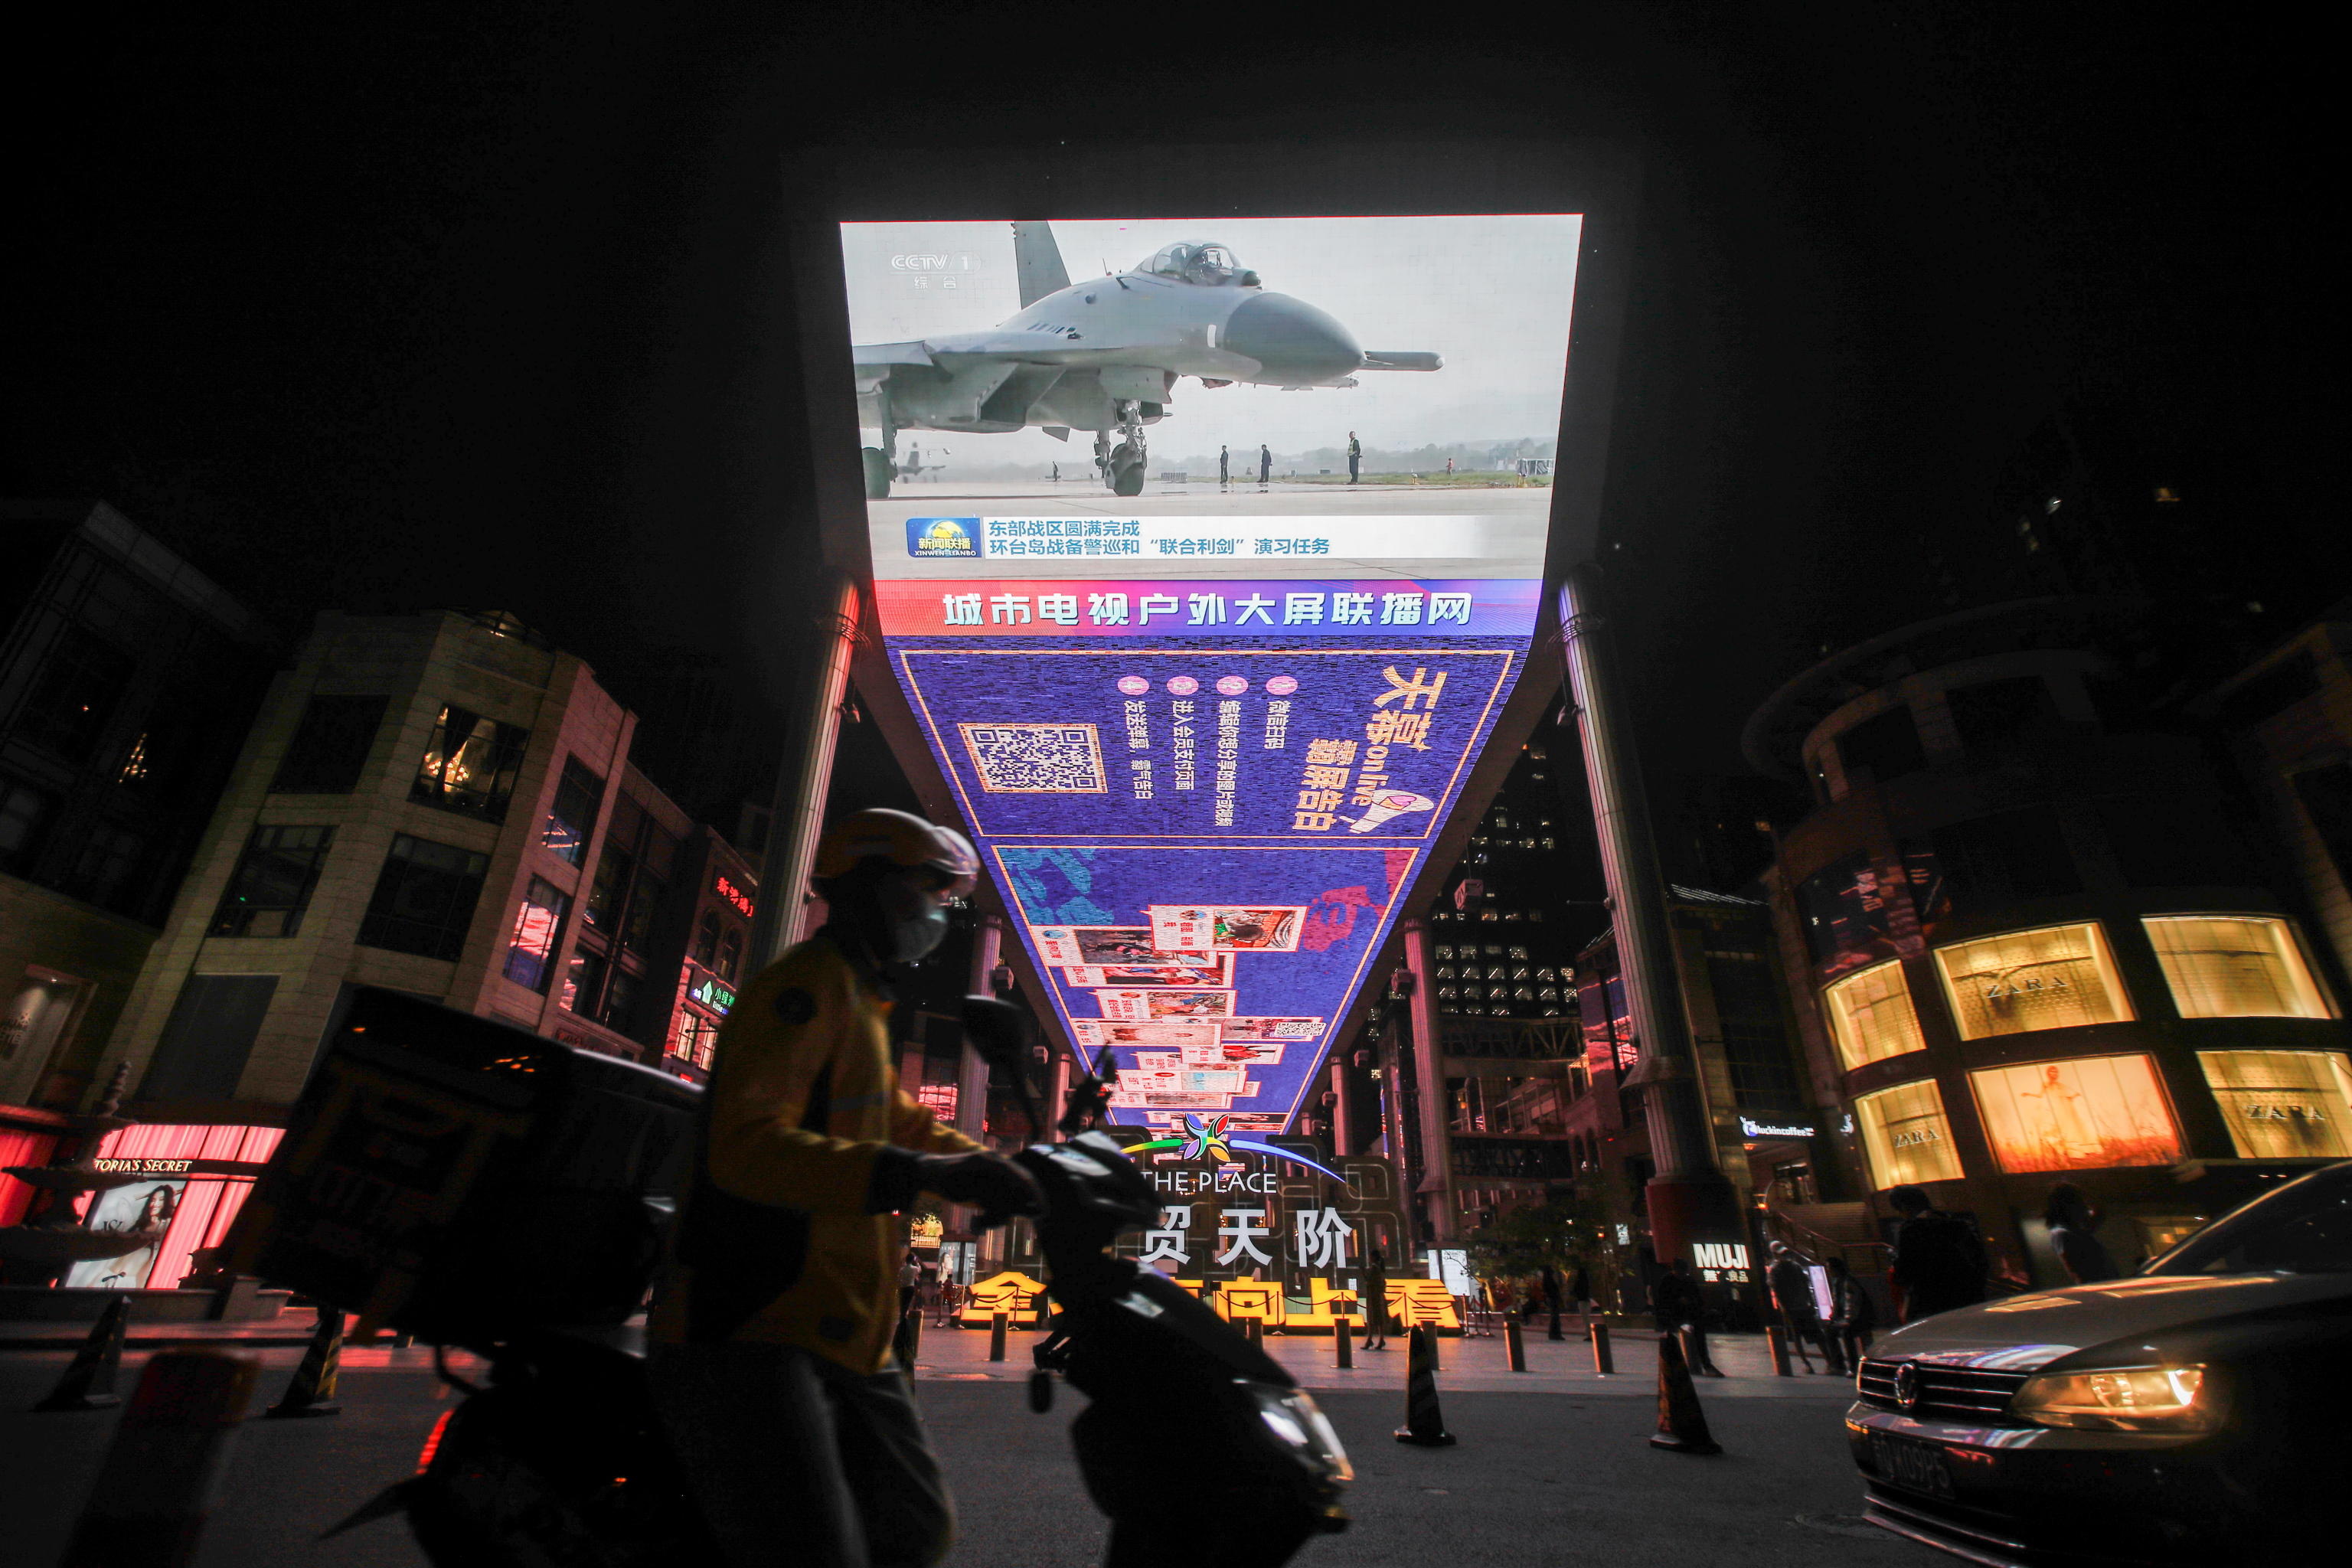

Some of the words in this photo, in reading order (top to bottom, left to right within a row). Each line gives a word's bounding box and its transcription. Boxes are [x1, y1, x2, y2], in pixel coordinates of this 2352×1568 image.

[891, 254, 948, 270] CCTV
[913, 276, 956, 289] 综合
[988, 520, 1140, 537] 东部战区圆满完成
[918, 537, 971, 550] 新闻联播
[942, 592, 1474, 627] 城市电视户外大屏联播网
[1365, 665, 1448, 751] 天幕
[1264, 700, 1292, 750] 微信扫码
[1171, 700, 1195, 791] 进入会员支付页面
[1214, 700, 1242, 827] 编辑你想分享的图片或视频
[1292, 737, 1359, 831] 霸屏告白
[1985, 977, 2068, 998] ZARA
[2246, 1104, 2326, 1120] ZARA
[1895, 1129, 1940, 1148] ZARA
[143, 1159, 193, 1171] SECRET
[1140, 1171, 1188, 1192] THE
[1199, 1171, 1277, 1194] PLACE
[1692, 1243, 1750, 1269] MUJI
[1702, 1269, 1750, 1283] 無良品
[959, 1271, 1461, 1328] 全向上看
